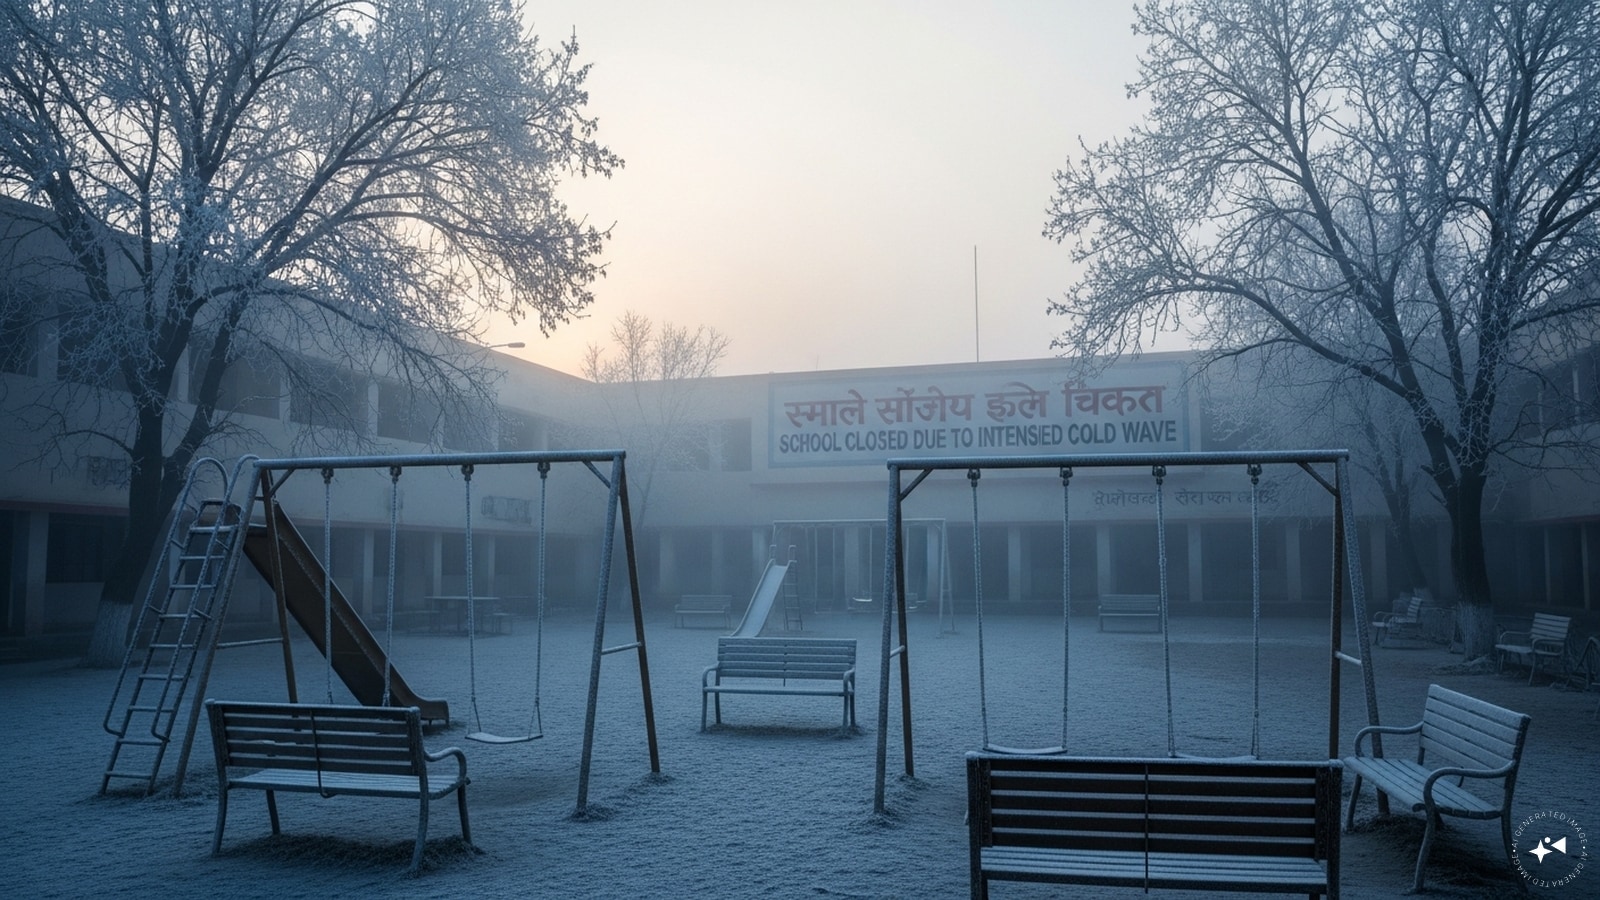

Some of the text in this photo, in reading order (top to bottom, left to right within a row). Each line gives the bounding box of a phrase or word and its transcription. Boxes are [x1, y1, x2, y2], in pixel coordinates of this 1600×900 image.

[779, 432, 842, 453] SCHOOL
[845, 430, 908, 452] CLOSED
[913, 429, 946, 449] DUE
[951, 428, 973, 449] TO
[1068, 422, 1117, 445] COLD
[1122, 420, 1177, 442] WAVE
